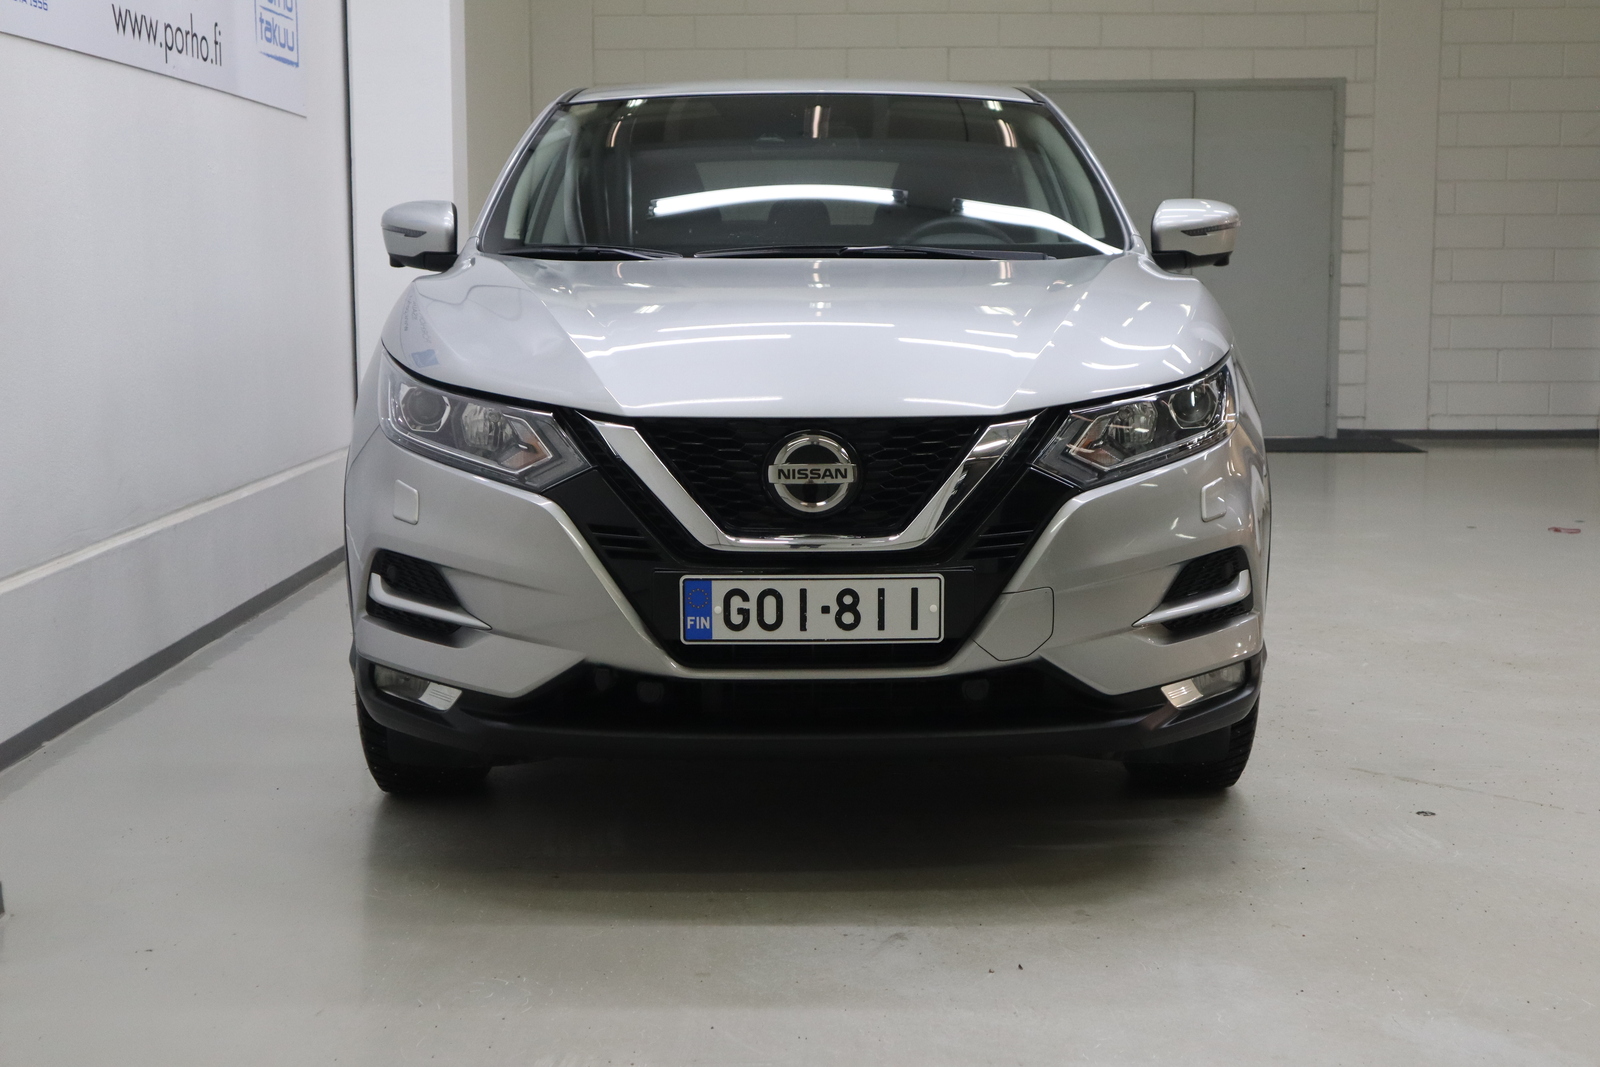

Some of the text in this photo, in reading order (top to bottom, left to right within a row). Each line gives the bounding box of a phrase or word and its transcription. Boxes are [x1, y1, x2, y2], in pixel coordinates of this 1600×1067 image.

[111, 3, 222, 67] www.porho.fi
[259, 12, 295, 52] takuu
[777, 467, 848, 480] NISSAN
[686, 616, 710, 629] FIN
[723, 587, 919, 632] GOI-811
